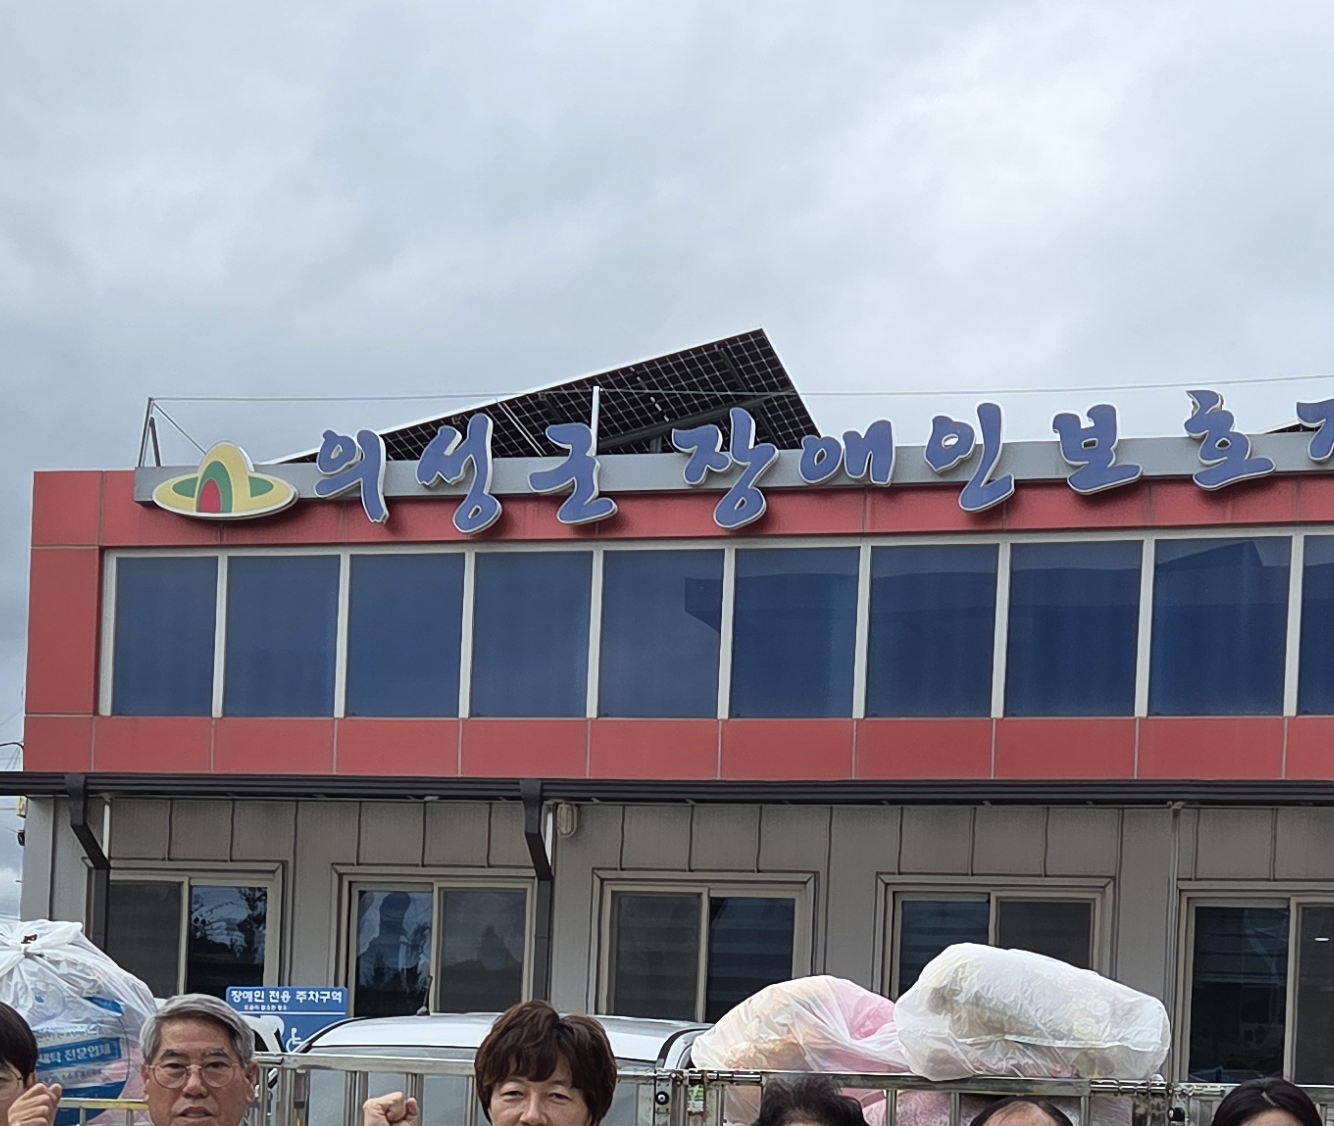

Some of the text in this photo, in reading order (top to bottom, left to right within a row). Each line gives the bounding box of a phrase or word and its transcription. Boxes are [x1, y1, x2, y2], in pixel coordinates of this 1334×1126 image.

[313, 412, 620, 535] 의성군
[230, 990, 343, 1004] 장애인 전용 주차구역
